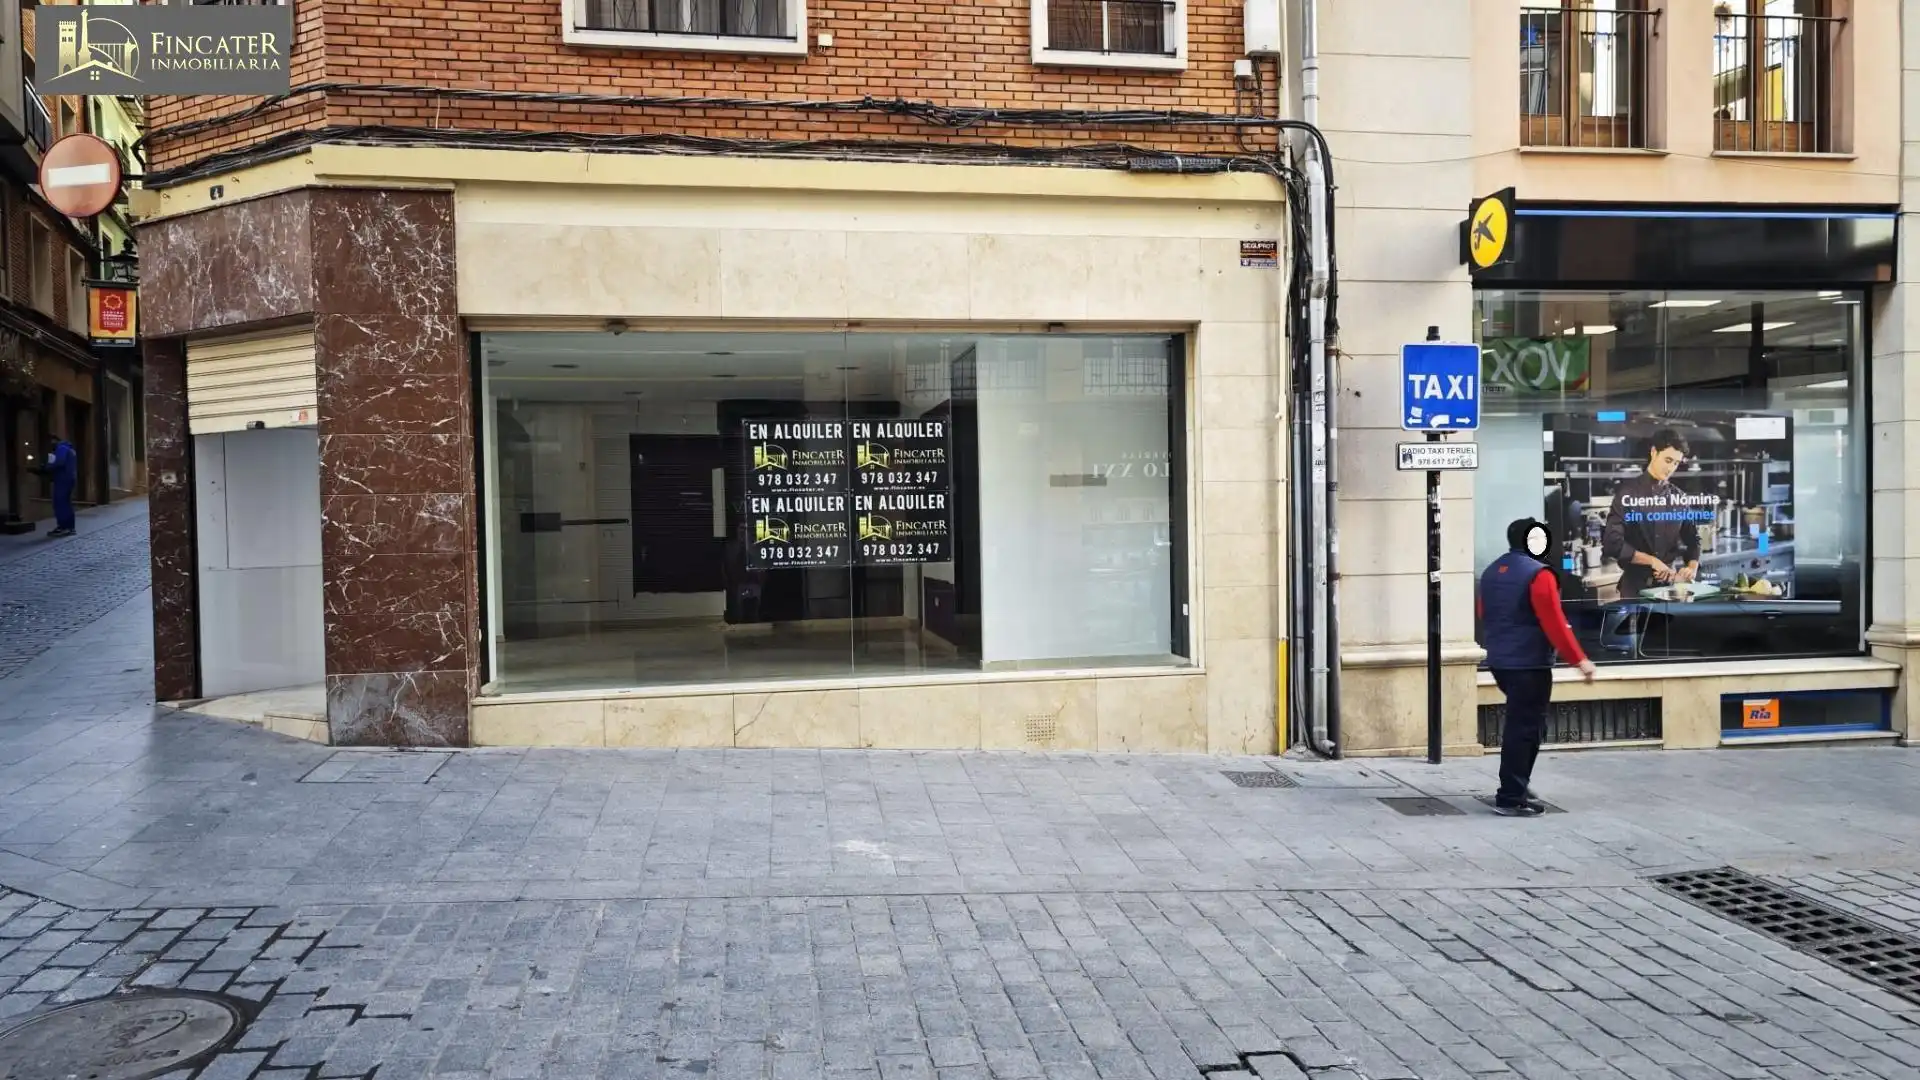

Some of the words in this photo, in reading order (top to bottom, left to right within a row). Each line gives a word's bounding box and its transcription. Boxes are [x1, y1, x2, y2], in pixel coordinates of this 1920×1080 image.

[1408, 374, 1474, 400] TAXI
[750, 424, 768, 440] EN
[774, 423, 843, 440] ALQUILER
[853, 423, 871, 439] EN
[876, 422, 943, 438] ALQUILER
[792, 450, 845, 460] FINCATER
[894, 448, 945, 458] FINCATER
[1401, 447, 1426, 455] RADIO
[758, 474, 782, 486] 978
[786, 473, 810, 485] 032
[815, 473, 837, 485] 347
[861, 472, 884, 484] 978
[888, 472, 911, 484] 032
[916, 471, 938, 483] 347
[752, 497, 770, 513] EN
[776, 496, 845, 513] ALQUILER
[855, 495, 873, 511] EN
[879, 494, 945, 510] ALQUILER
[1621, 494, 1667, 507] Cuenta
[1670, 492, 1720, 505] Nómina
[1624, 511, 1643, 522] sin
[1647, 508, 1718, 522] comisiones
[794, 522, 847, 533] FINCATER
[895, 520, 947, 530] FINCATER
[760, 547, 783, 560] 978
[788, 546, 812, 559] 032
[817, 545, 839, 558] 347
[863, 544, 886, 556] 978
[890, 543, 913, 556] 032
[918, 542, 940, 554] 347
[1750, 708, 1771, 719] Ria
